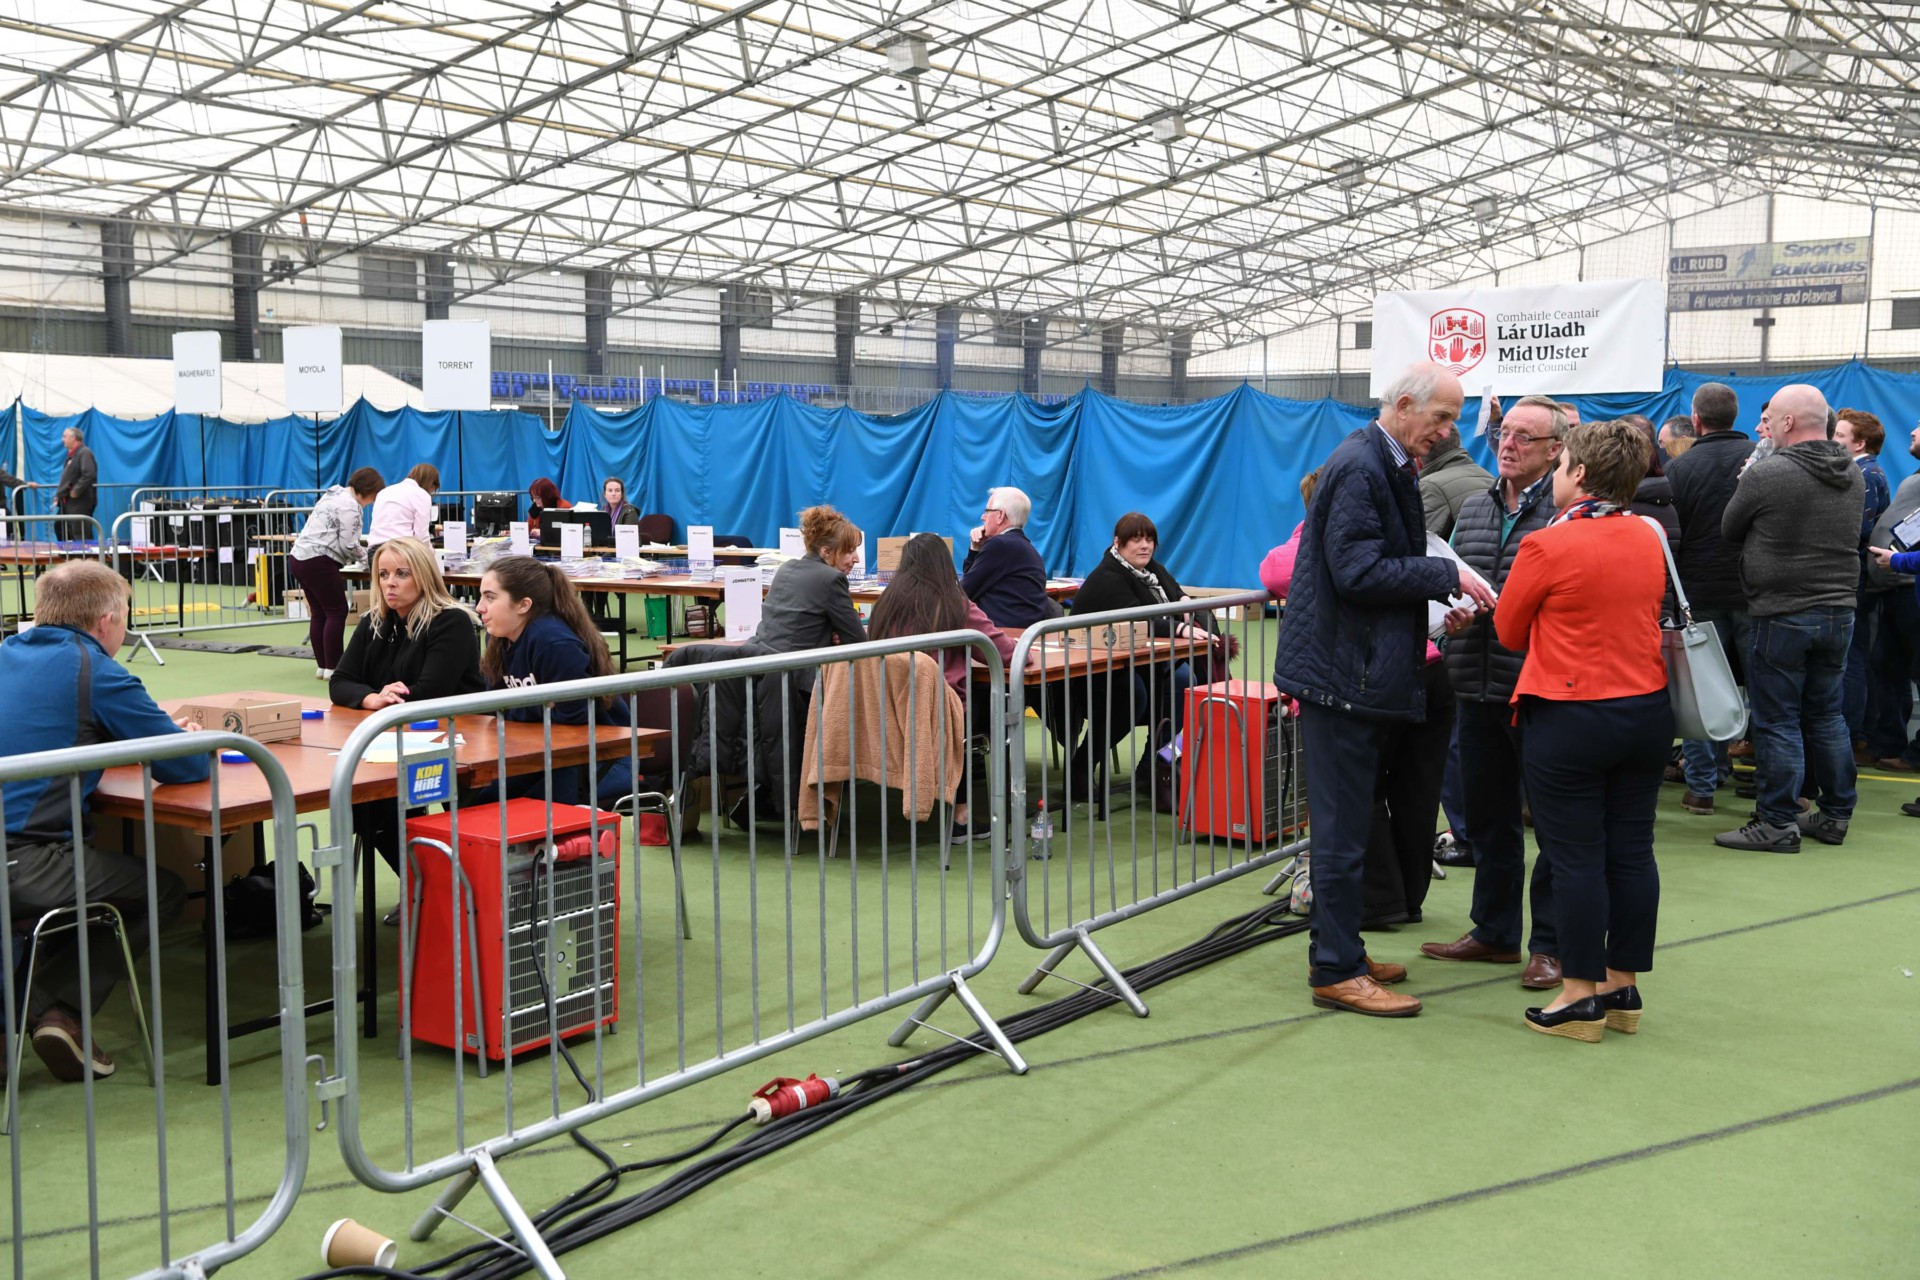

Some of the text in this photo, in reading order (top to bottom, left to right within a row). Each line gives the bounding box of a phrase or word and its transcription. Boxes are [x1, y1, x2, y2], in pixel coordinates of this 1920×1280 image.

[1784, 242, 1856, 257] Sports
[1689, 256, 1724, 271] RUBB
[1771, 262, 1867, 276] Buildings
[1693, 288, 1837, 309] All weather training and playing
[1496, 308, 1600, 322] Comhairle Ceantair
[1497, 320, 1586, 340] Lár Uladh
[1498, 344, 1590, 362] Mid Ulster
[298, 365, 326, 374] MOYOLA
[438, 361, 473, 370] TORRENT
[1497, 361, 1577, 374] District Council
[178, 369, 216, 378] MAGHERAFELT
[416, 763, 444, 780] KDM
[413, 776, 442, 793] HiRE
